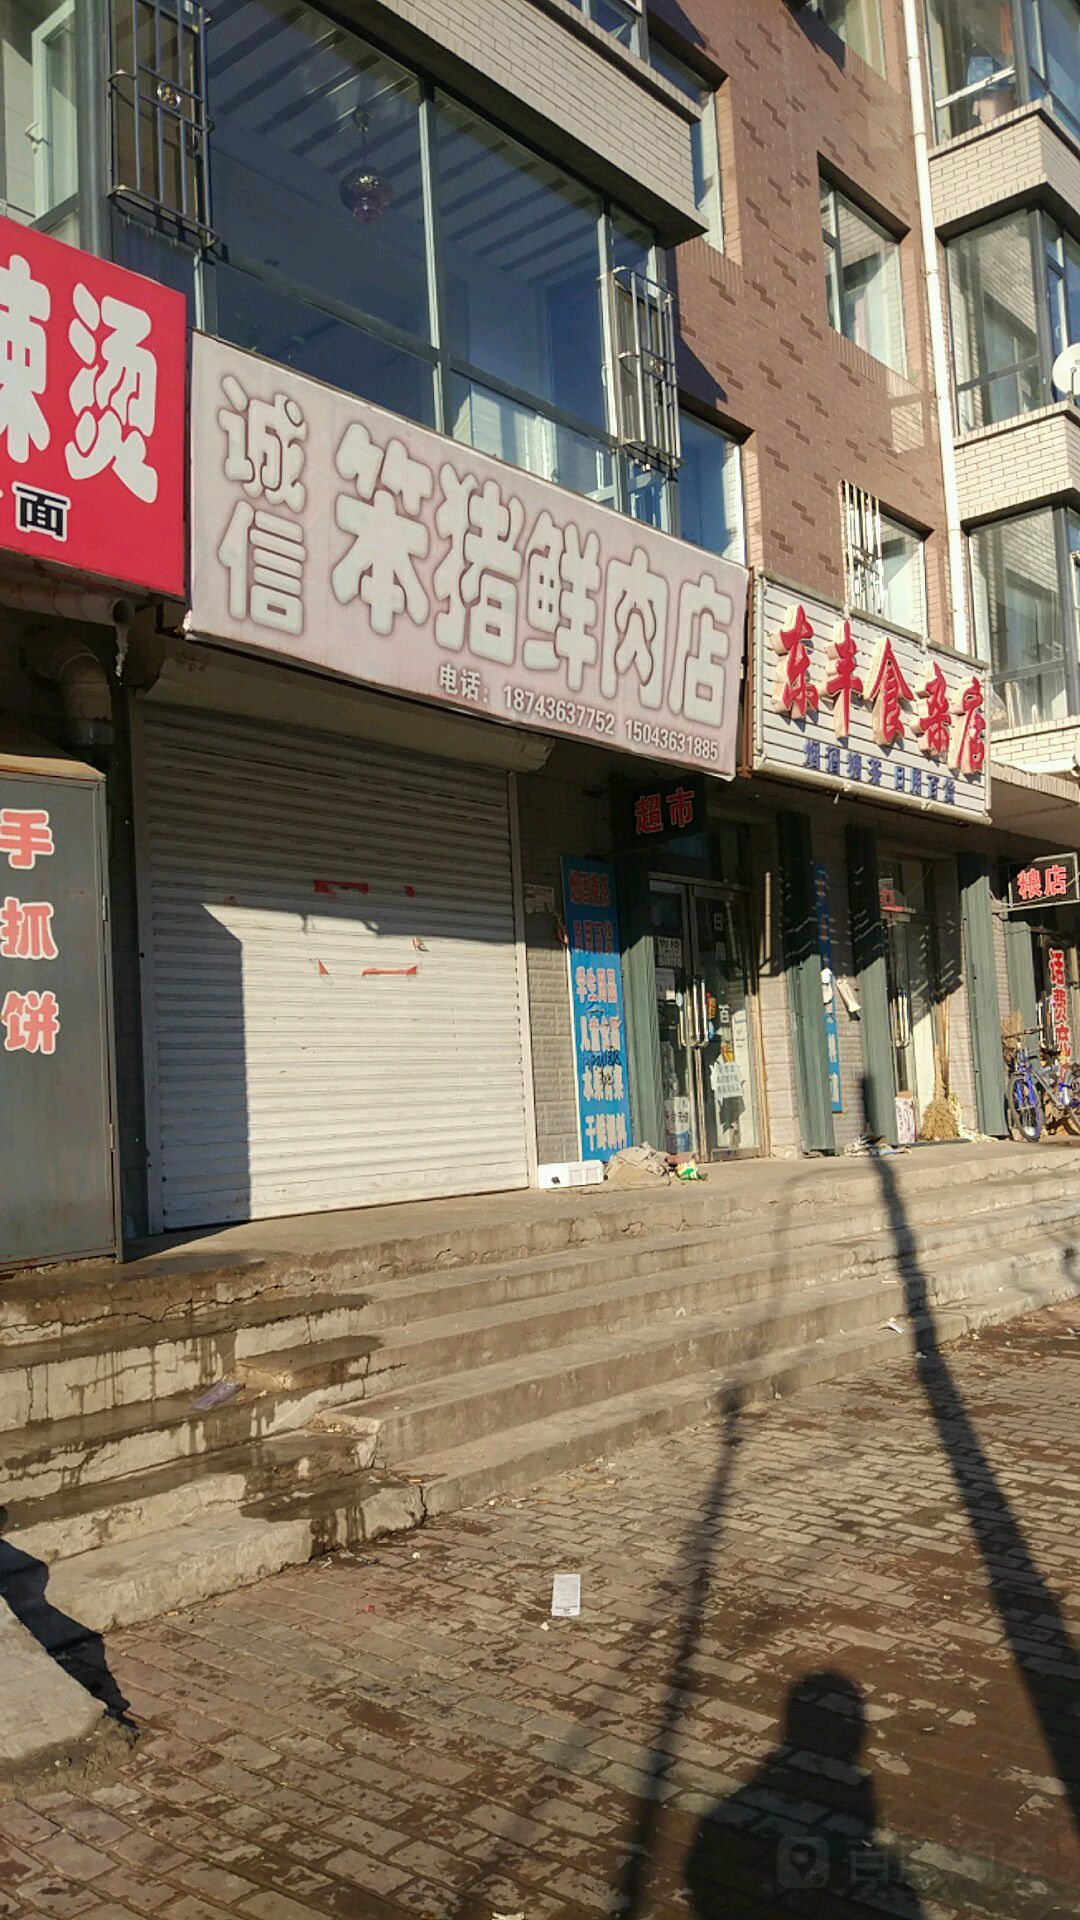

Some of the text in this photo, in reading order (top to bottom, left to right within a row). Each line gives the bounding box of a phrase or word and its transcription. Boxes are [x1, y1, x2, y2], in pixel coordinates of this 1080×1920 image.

[217, 375, 307, 635] 诚信
[332, 424, 734, 727] 笨猪鲜肉店
[503, 685, 616, 736] 18743637752
[625, 719, 720, 761] 15043631885
[775, 605, 986, 774] 东丰食杂店
[635, 787, 695, 835] 超市
[1017, 865, 1067, 900] 粮店
[0, 808, 60, 1055] 手抓饼
